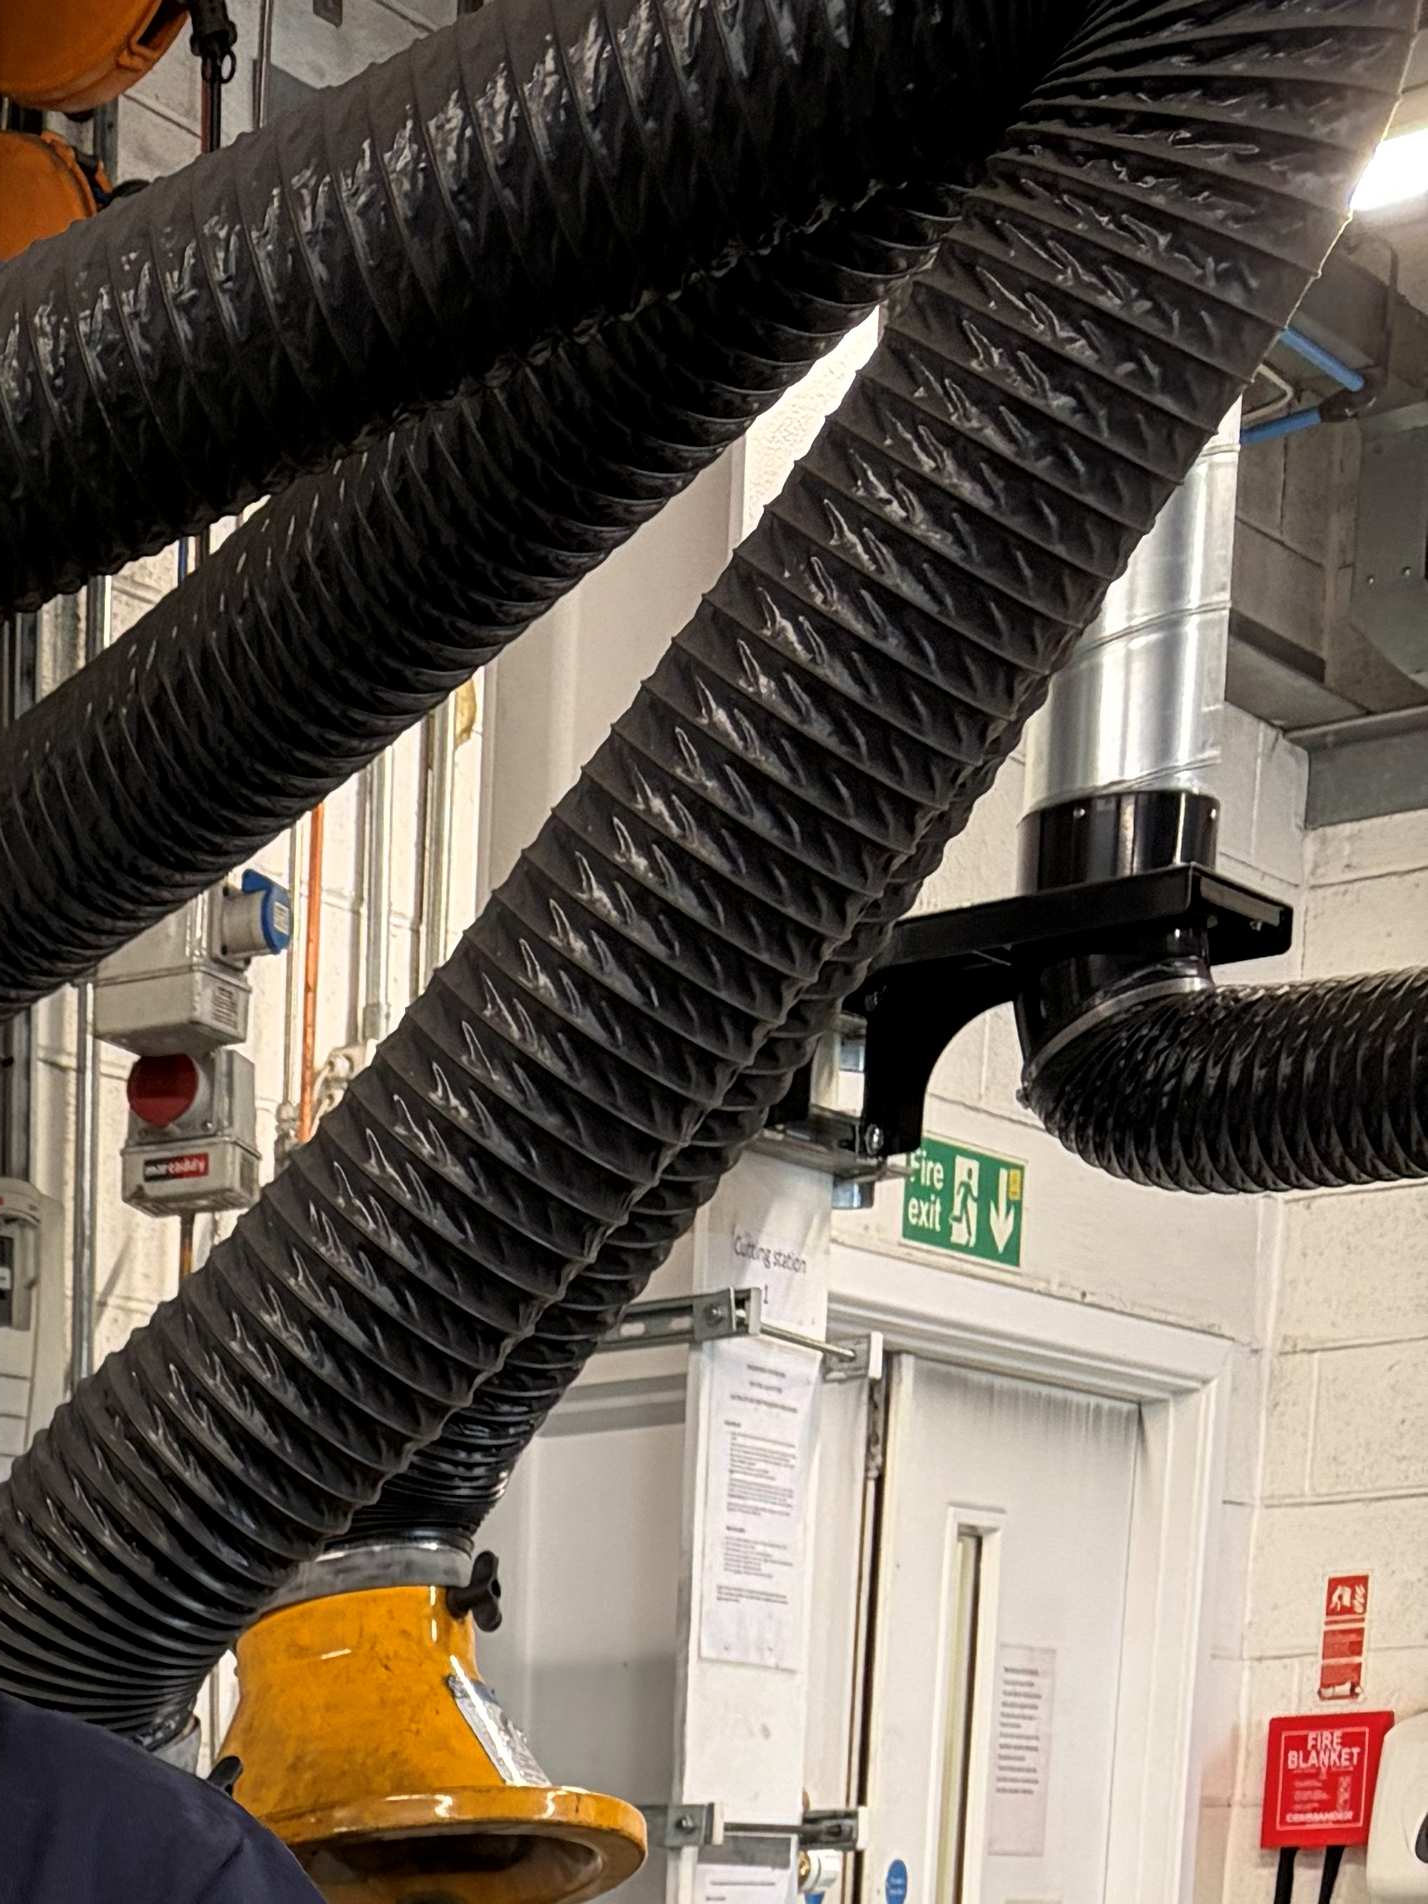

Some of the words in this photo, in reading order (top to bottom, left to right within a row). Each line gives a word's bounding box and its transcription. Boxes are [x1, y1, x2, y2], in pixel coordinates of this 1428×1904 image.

[908, 1194, 941, 1232] exit
[773, 1250, 807, 1274] station
[1307, 1730, 1342, 1751] FIRE
[1287, 1746, 1361, 1770] BLANKET
